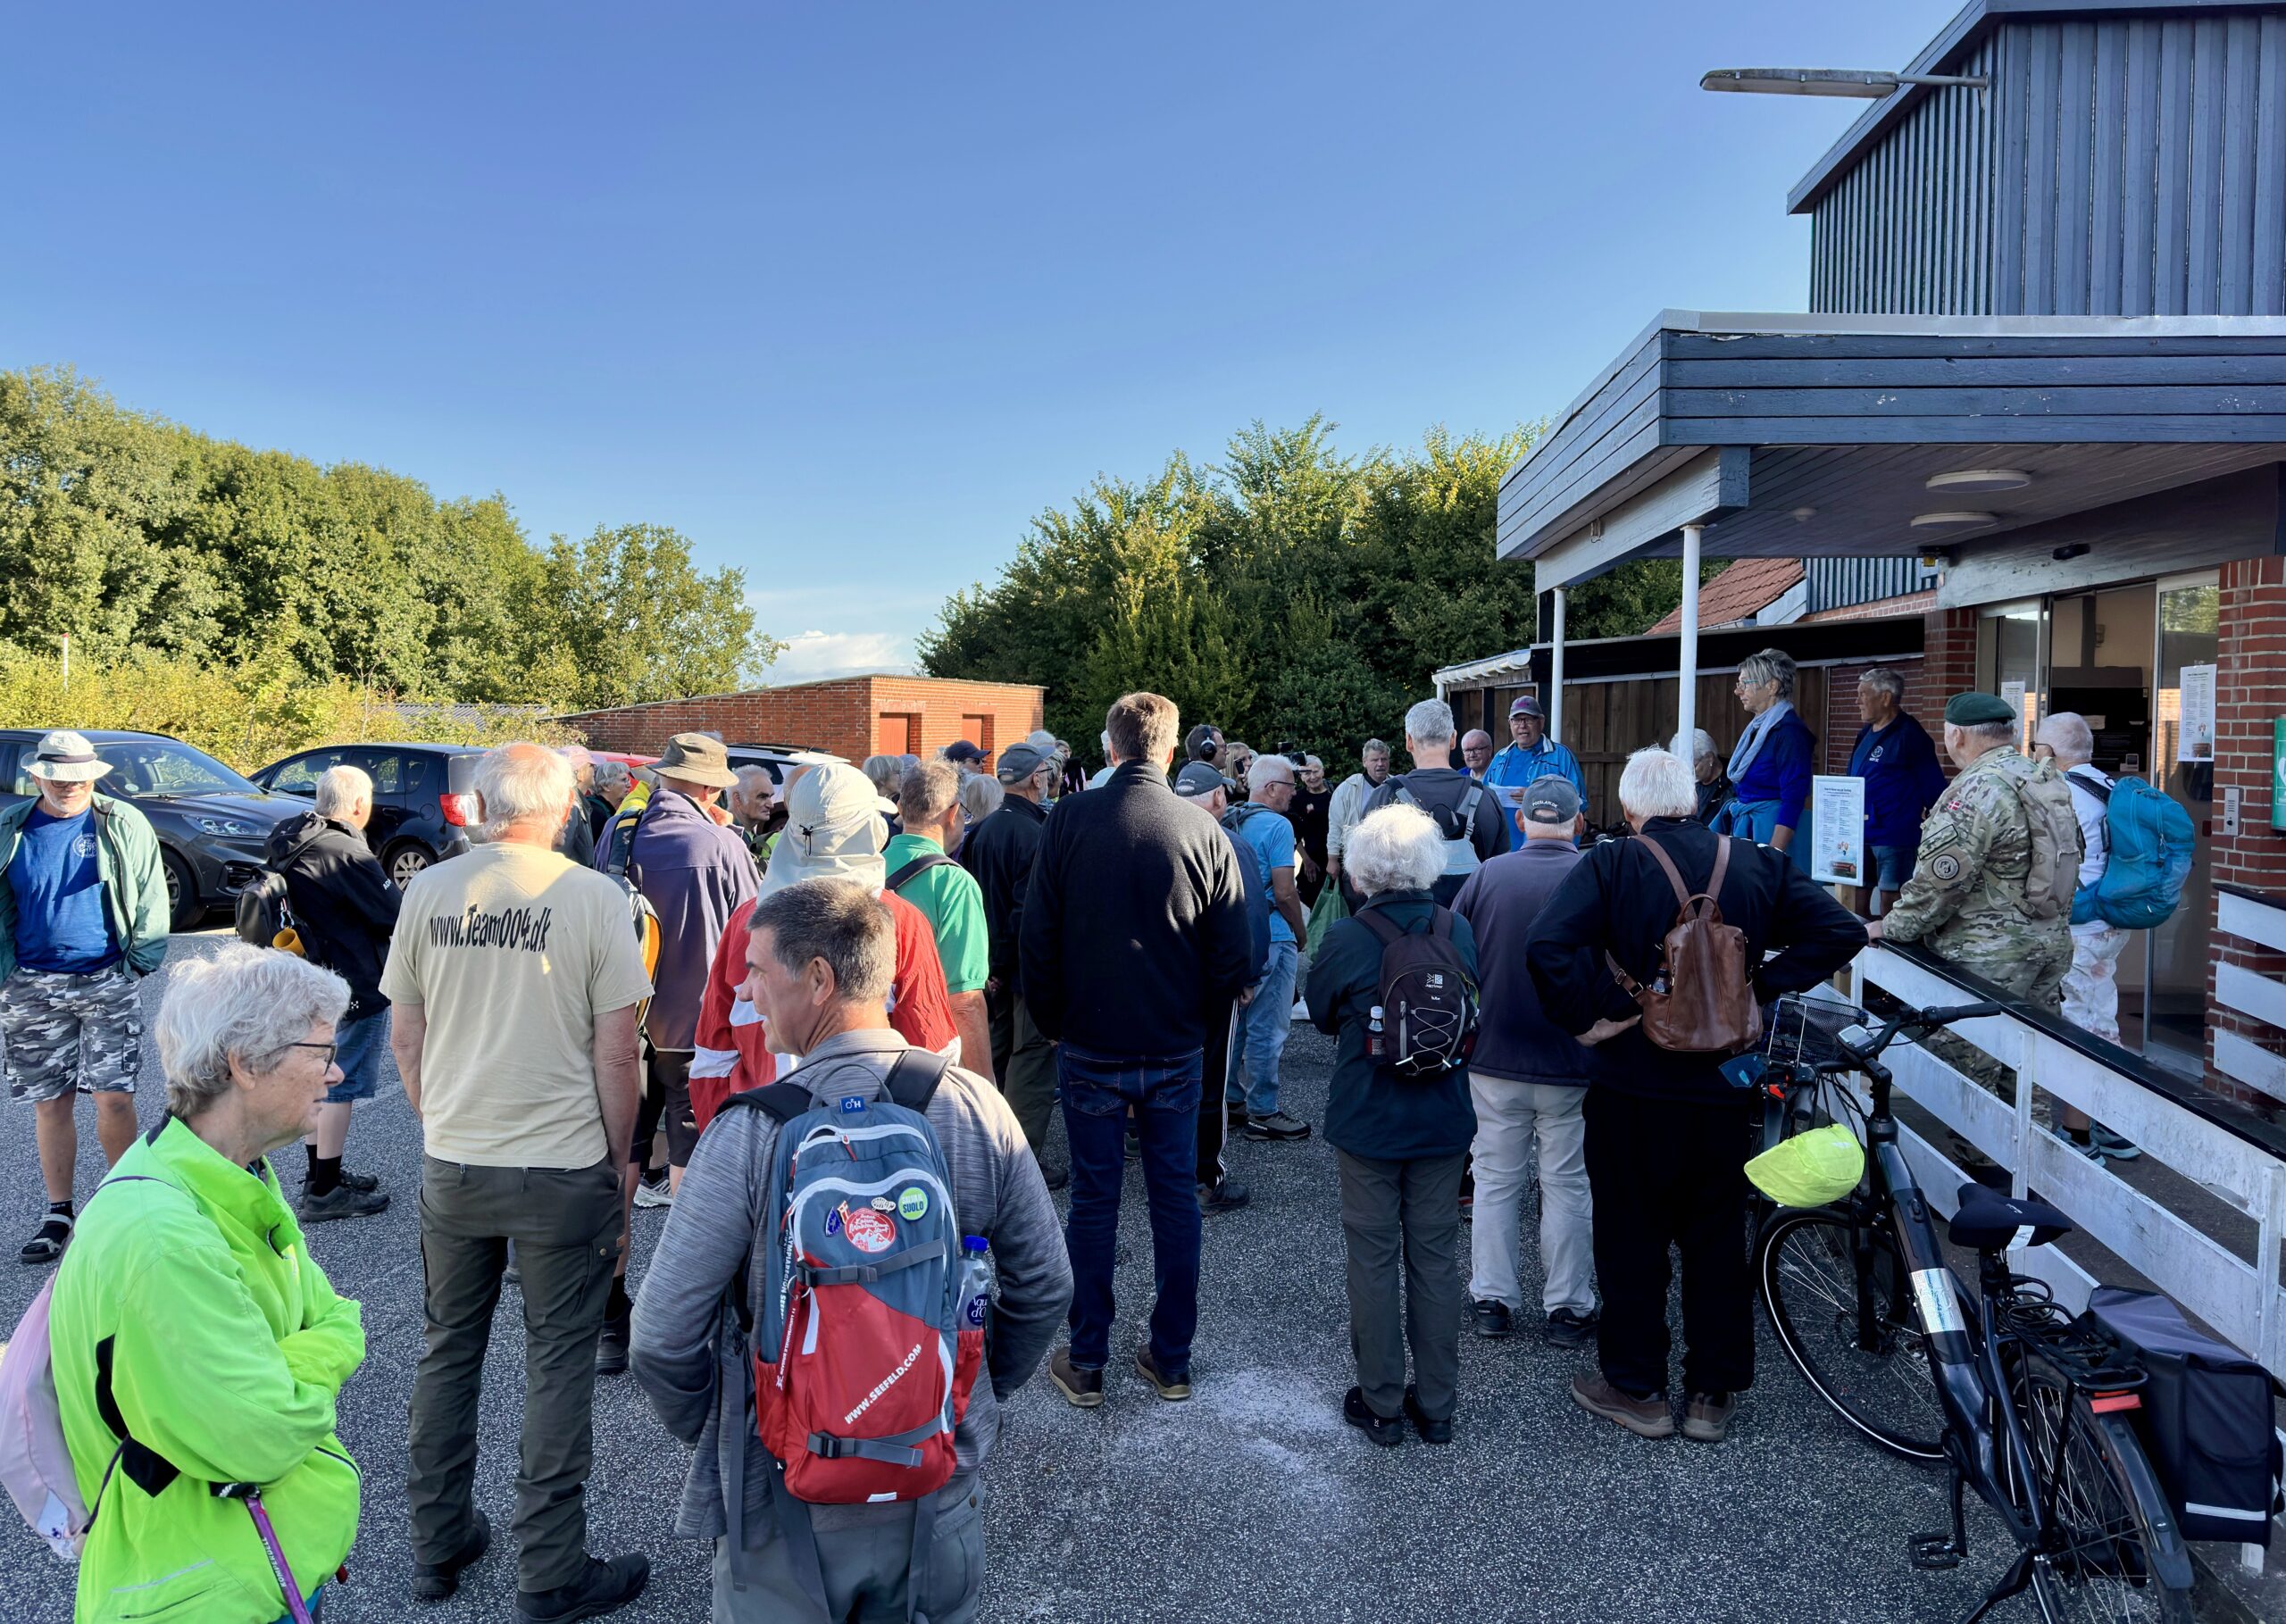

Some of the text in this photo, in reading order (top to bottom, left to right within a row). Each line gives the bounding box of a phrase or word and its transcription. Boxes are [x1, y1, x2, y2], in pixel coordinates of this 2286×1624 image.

[430, 904, 552, 953] www.Team004.dk
[903, 1201, 924, 1214] SUOLO
[780, 1232, 794, 1294] LYMPIAREGION
[844, 1344, 922, 1425] WWW.SEEFELD.COM
